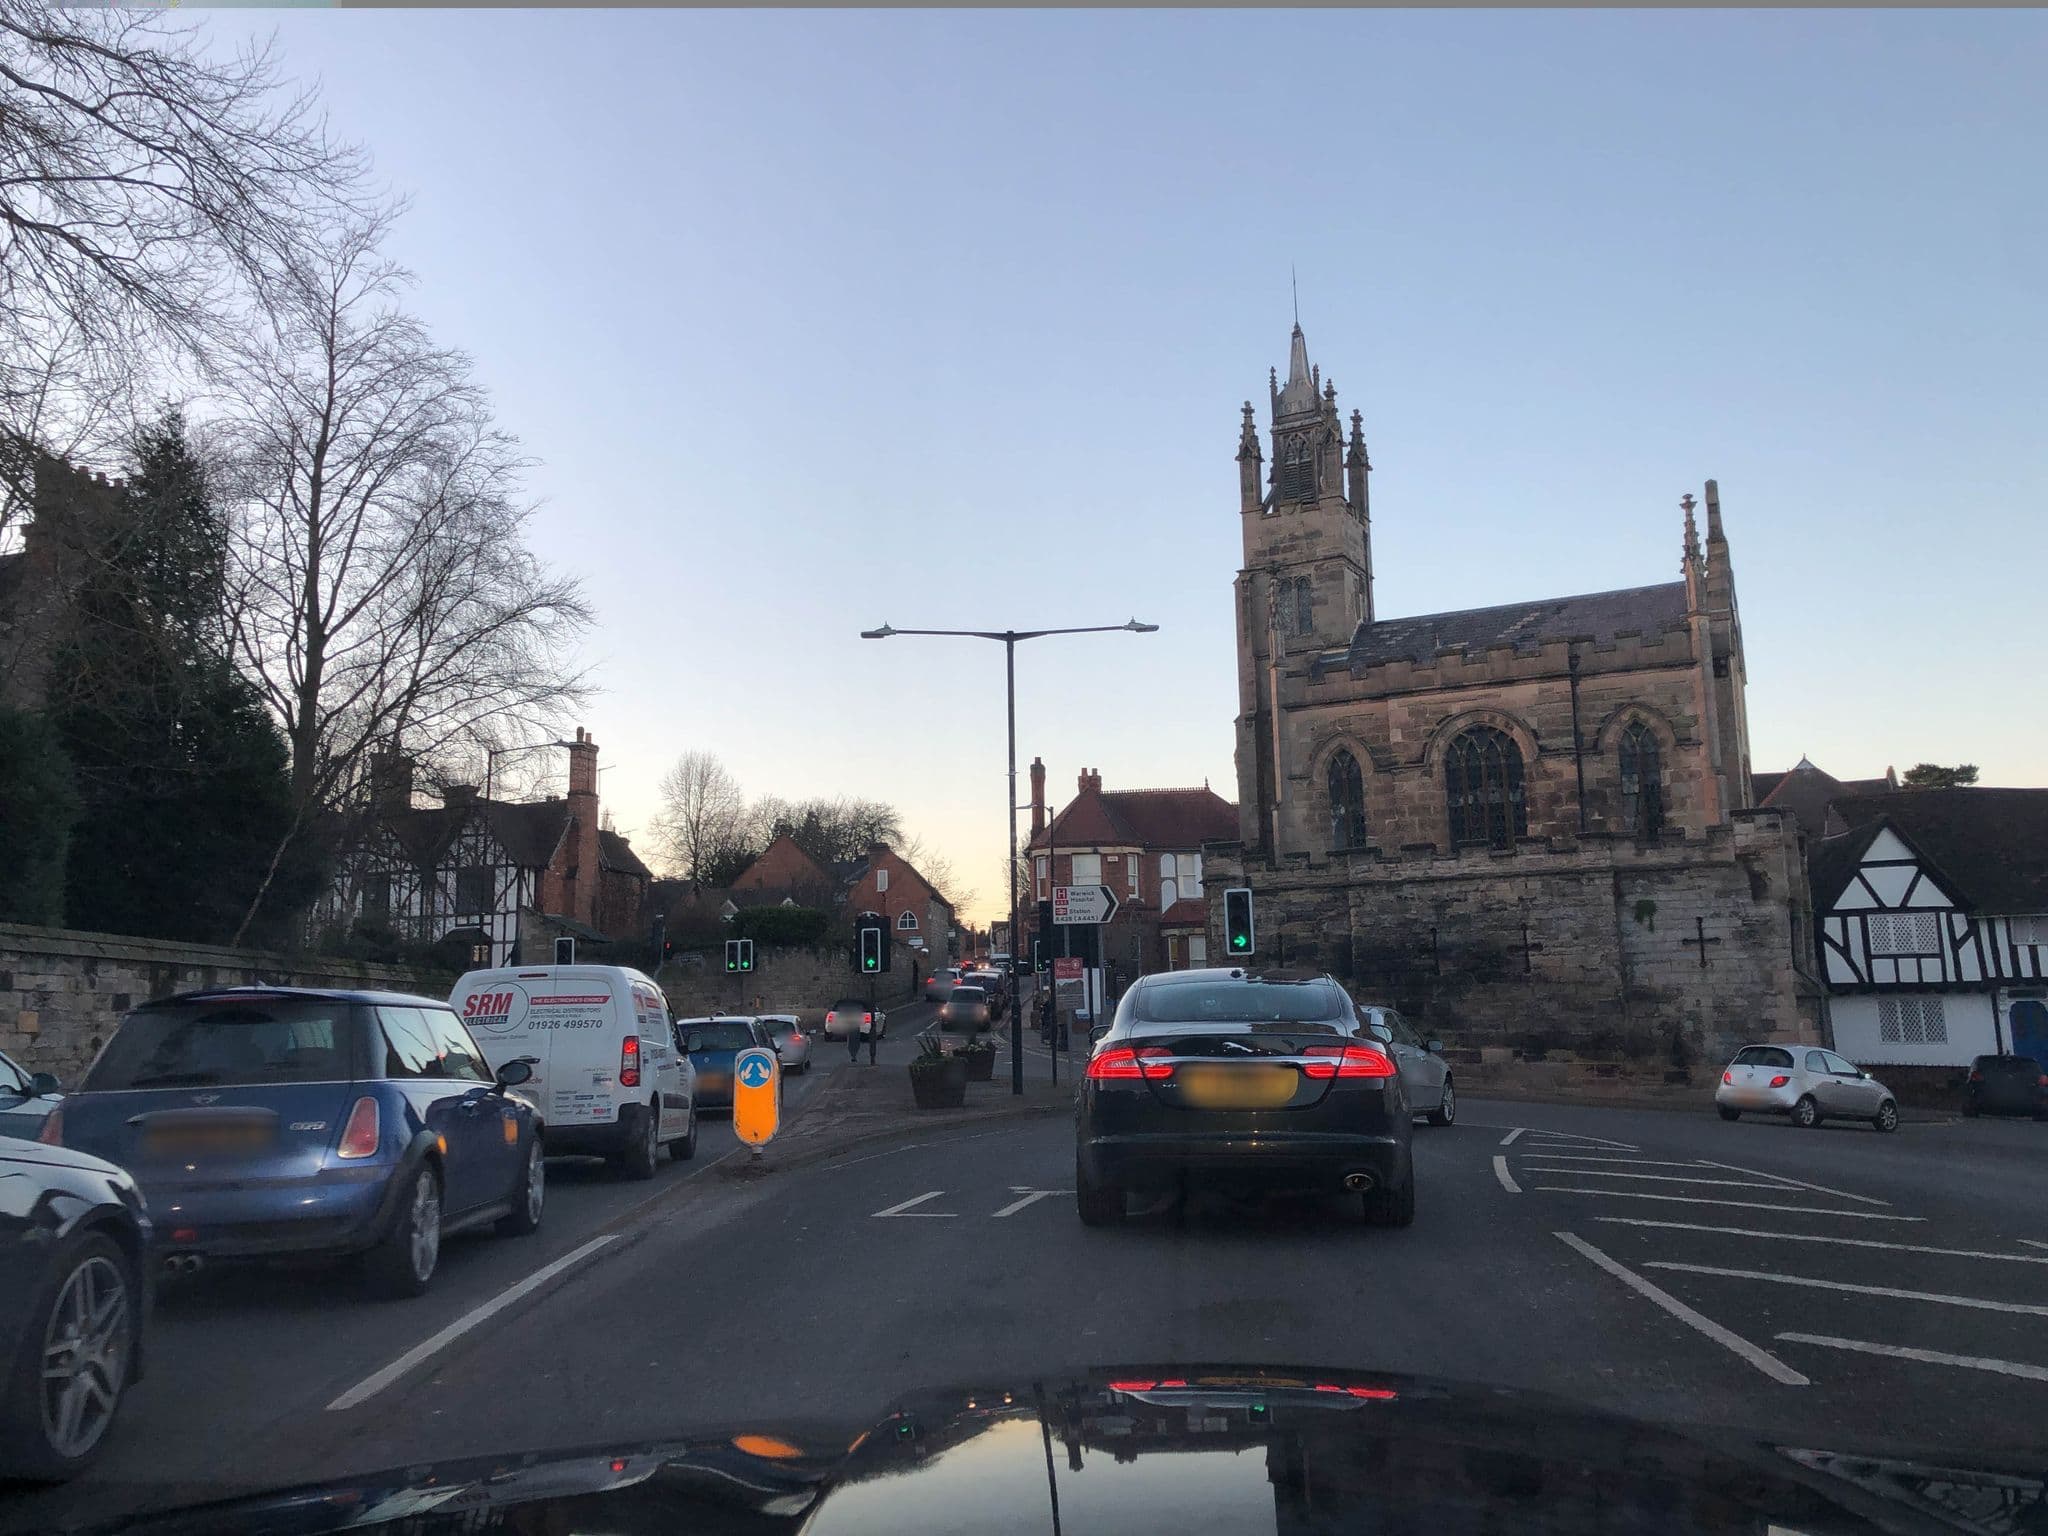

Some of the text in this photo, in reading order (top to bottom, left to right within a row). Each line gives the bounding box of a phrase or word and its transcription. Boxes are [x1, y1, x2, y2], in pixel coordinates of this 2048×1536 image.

[463, 992, 514, 1017] SRM
[465, 1016, 508, 1026] ELECTRICAL
[528, 1019, 603, 1030] 01926 499570
